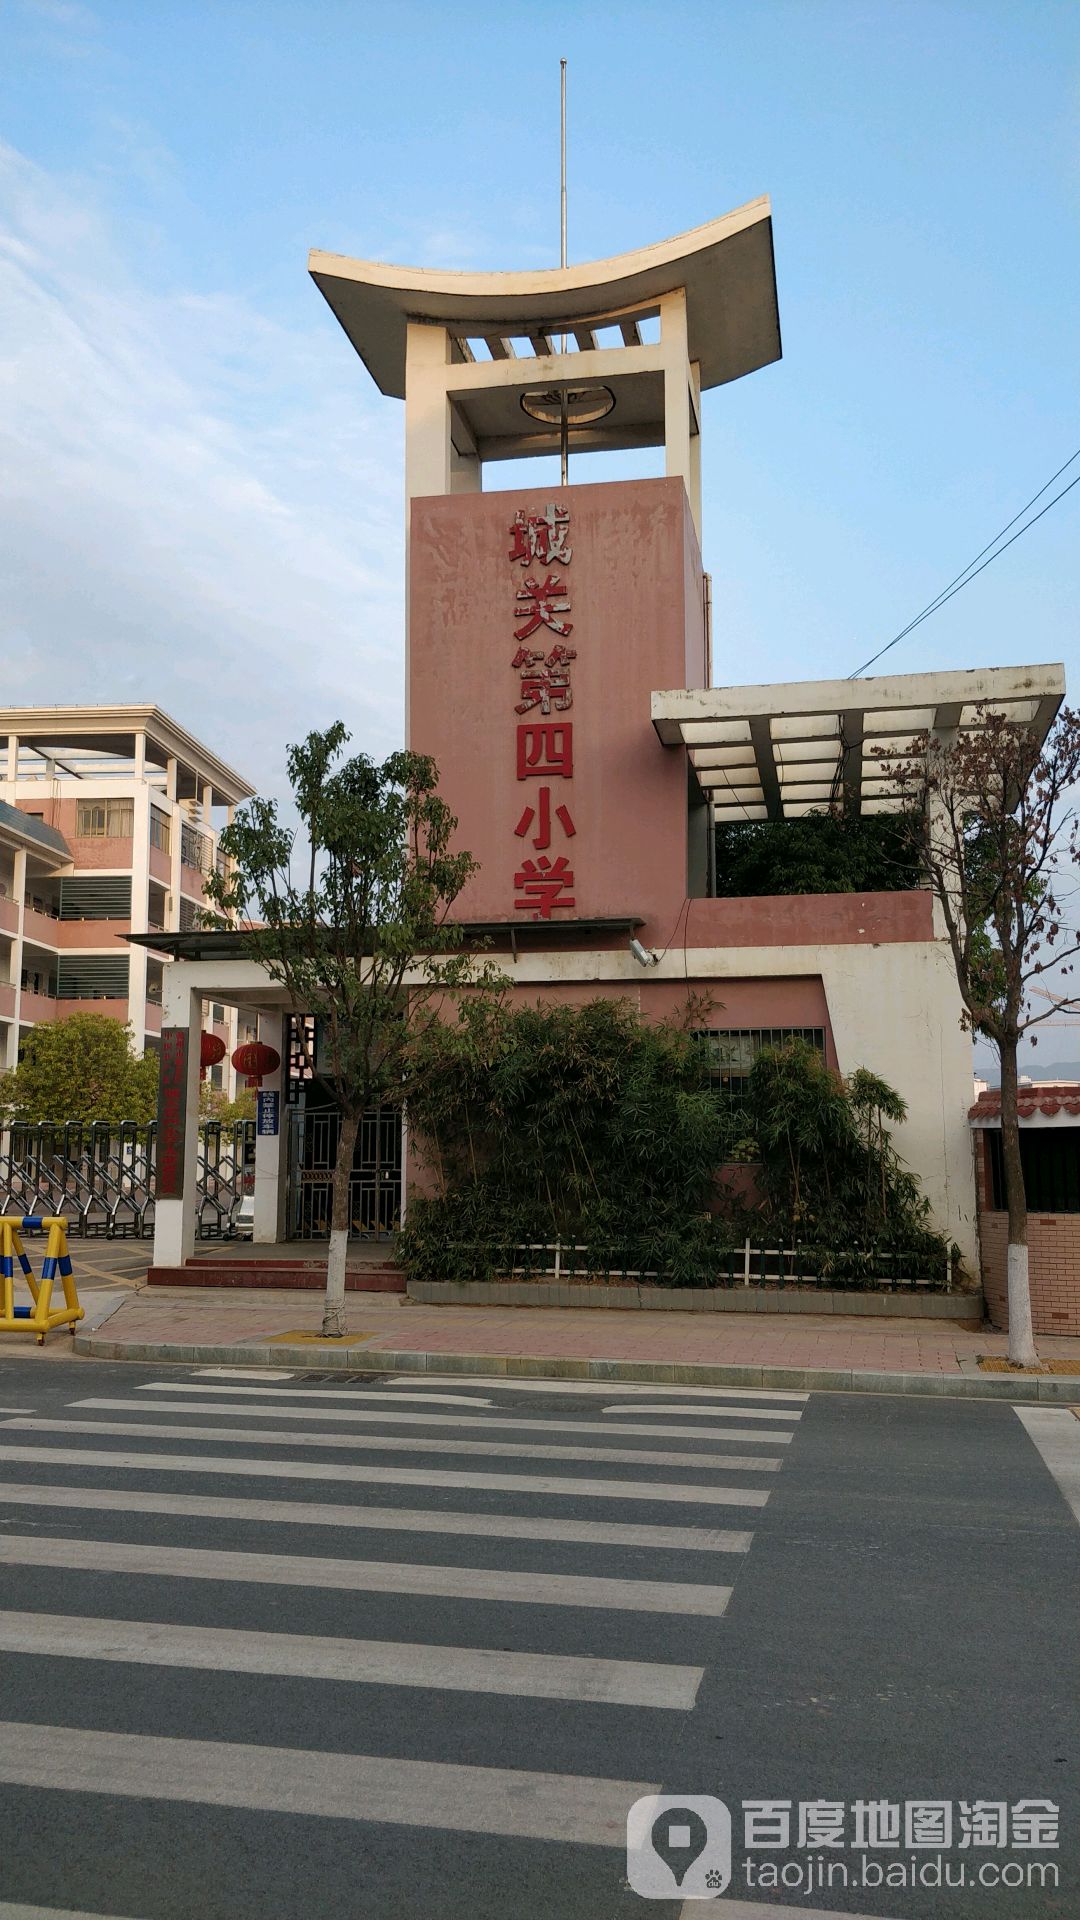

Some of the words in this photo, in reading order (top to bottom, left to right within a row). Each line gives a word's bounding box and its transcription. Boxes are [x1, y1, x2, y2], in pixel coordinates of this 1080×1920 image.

[509, 504, 577, 920] 城关第四小学
